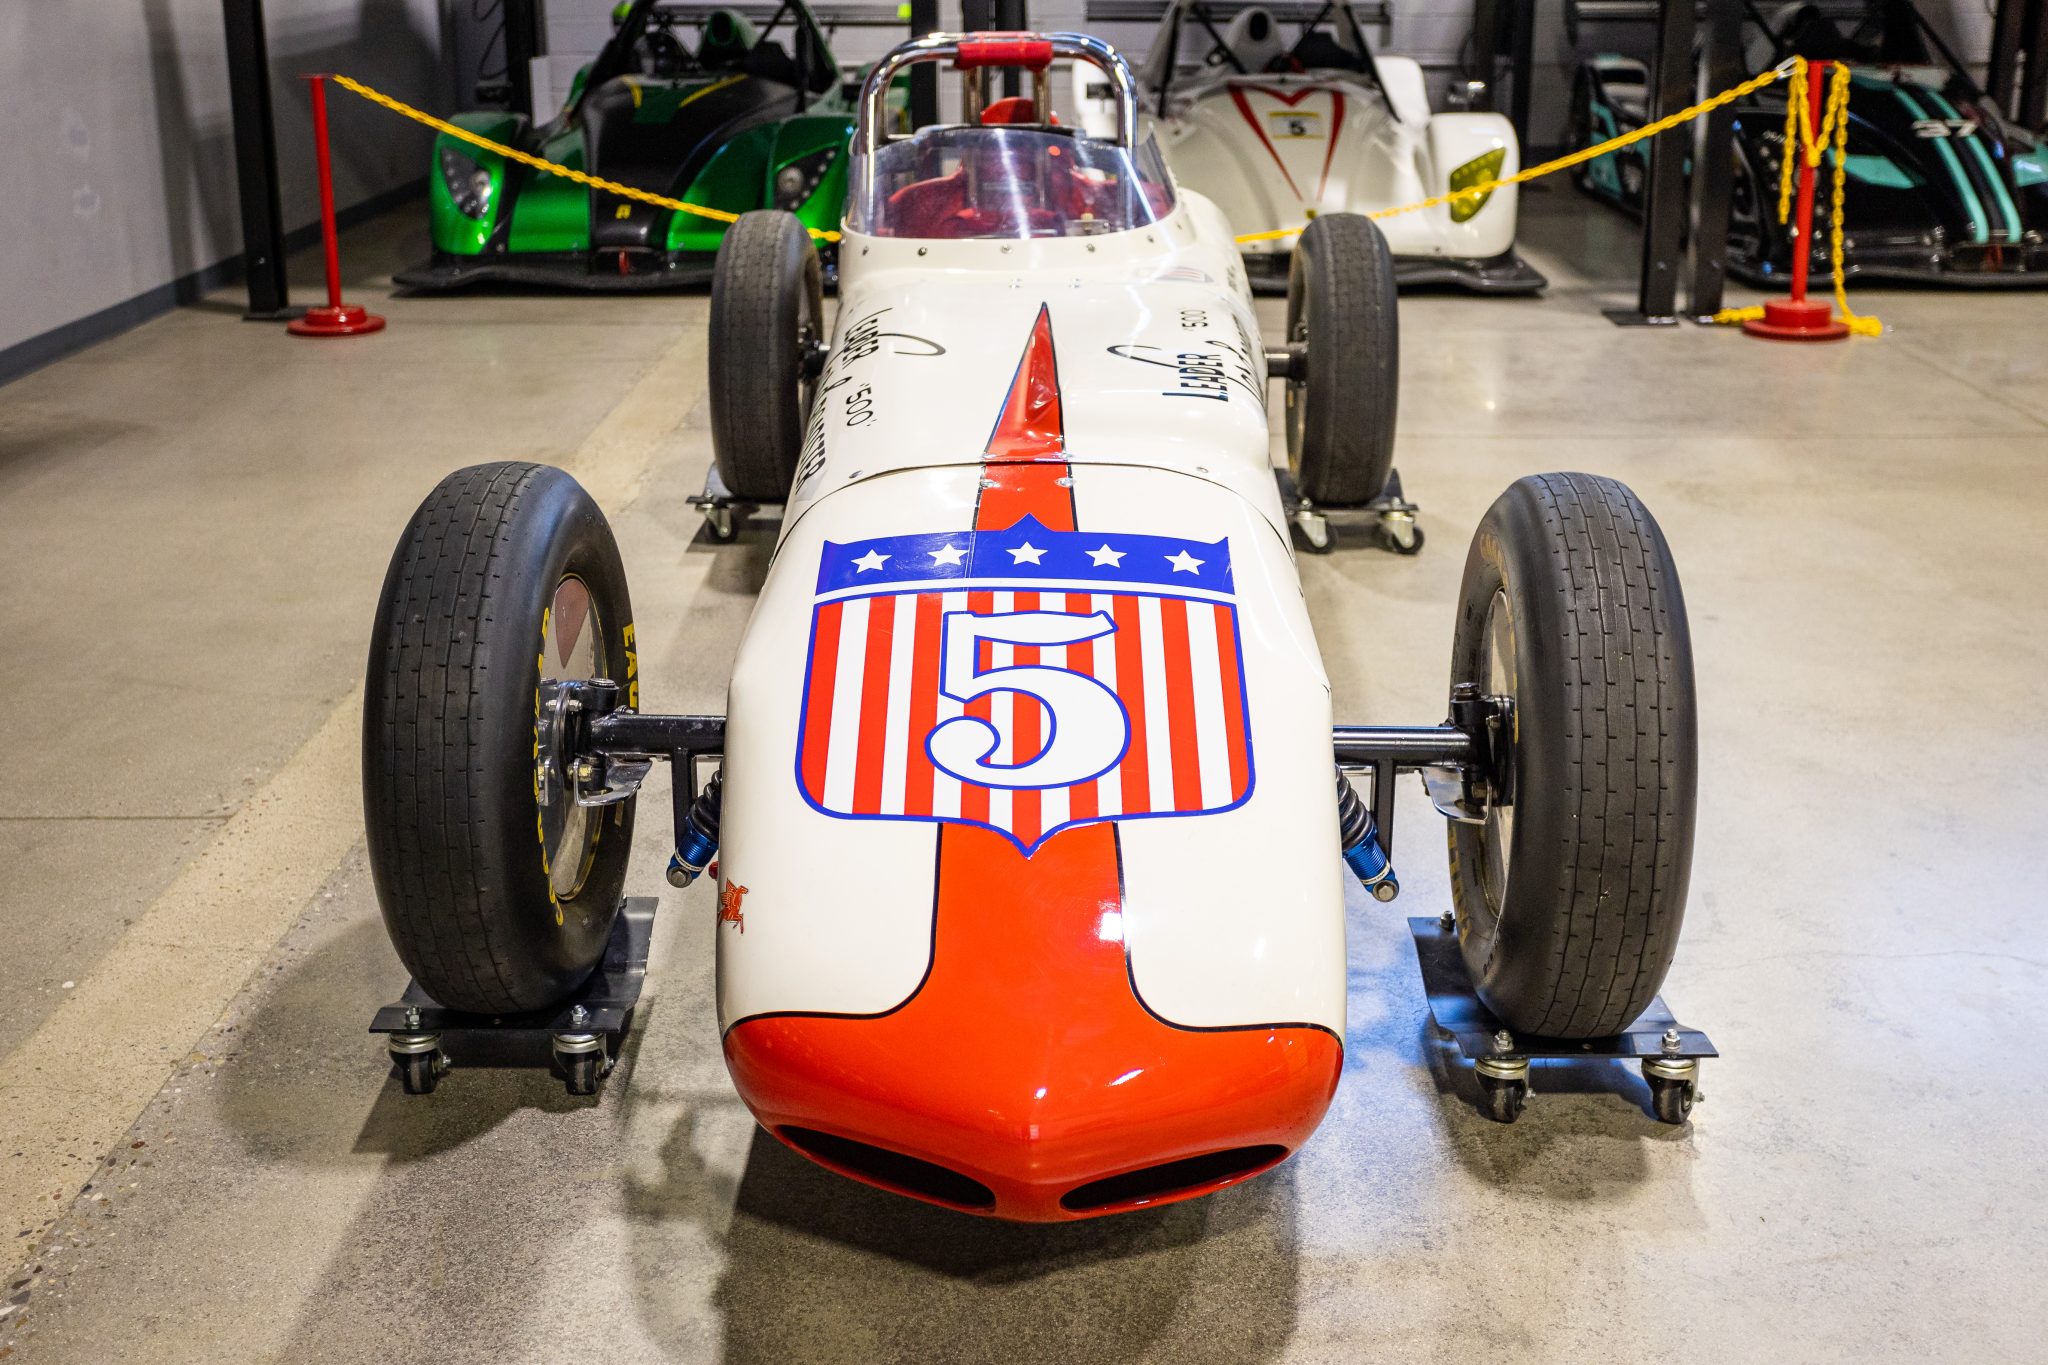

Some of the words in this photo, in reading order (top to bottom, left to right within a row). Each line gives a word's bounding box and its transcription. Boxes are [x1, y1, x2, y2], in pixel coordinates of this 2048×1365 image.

[1290, 120, 1306, 136] 5
[1912, 119, 1978, 138] 37
[842, 307, 893, 370] LEADER
[1161, 353, 1229, 402] LEADER
[924, 610, 1131, 790] 5
